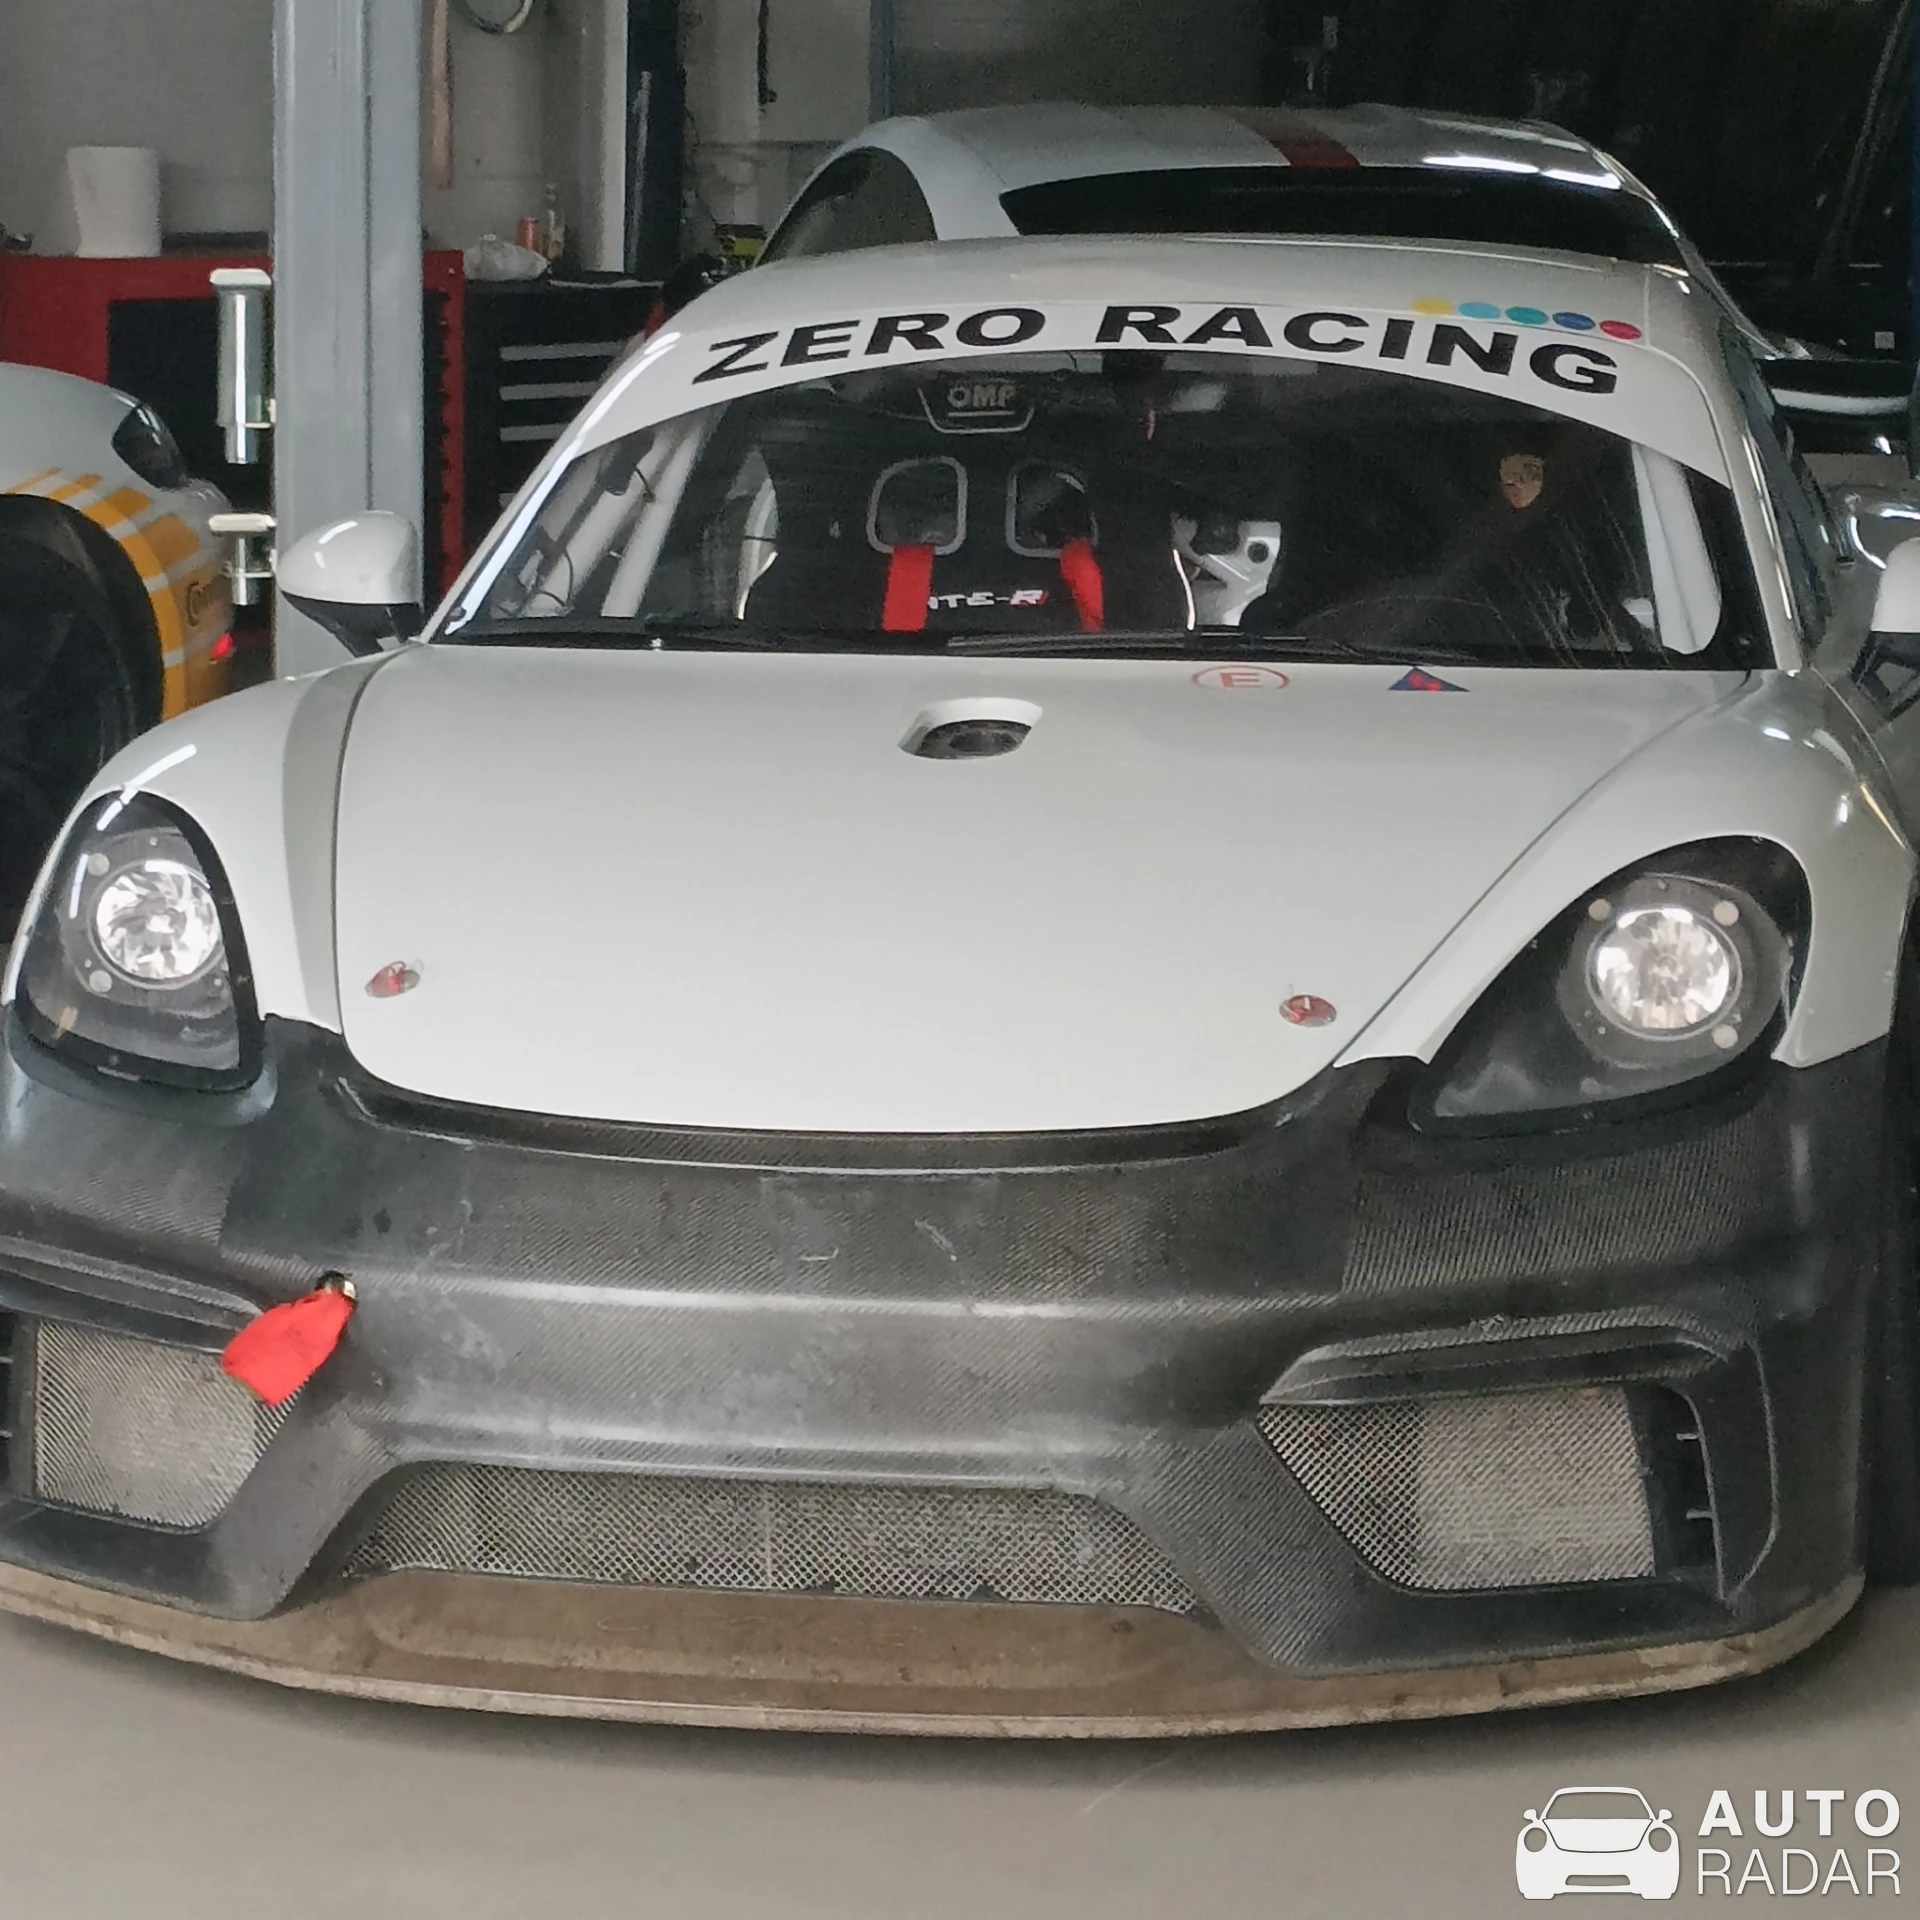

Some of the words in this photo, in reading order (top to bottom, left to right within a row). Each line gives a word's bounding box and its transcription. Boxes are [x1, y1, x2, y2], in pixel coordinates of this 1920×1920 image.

[693, 307, 1046, 385] ZERO
[1095, 305, 1617, 394] RACING
[947, 384, 1016, 408] OMP
[1219, 671, 1263, 689] E
